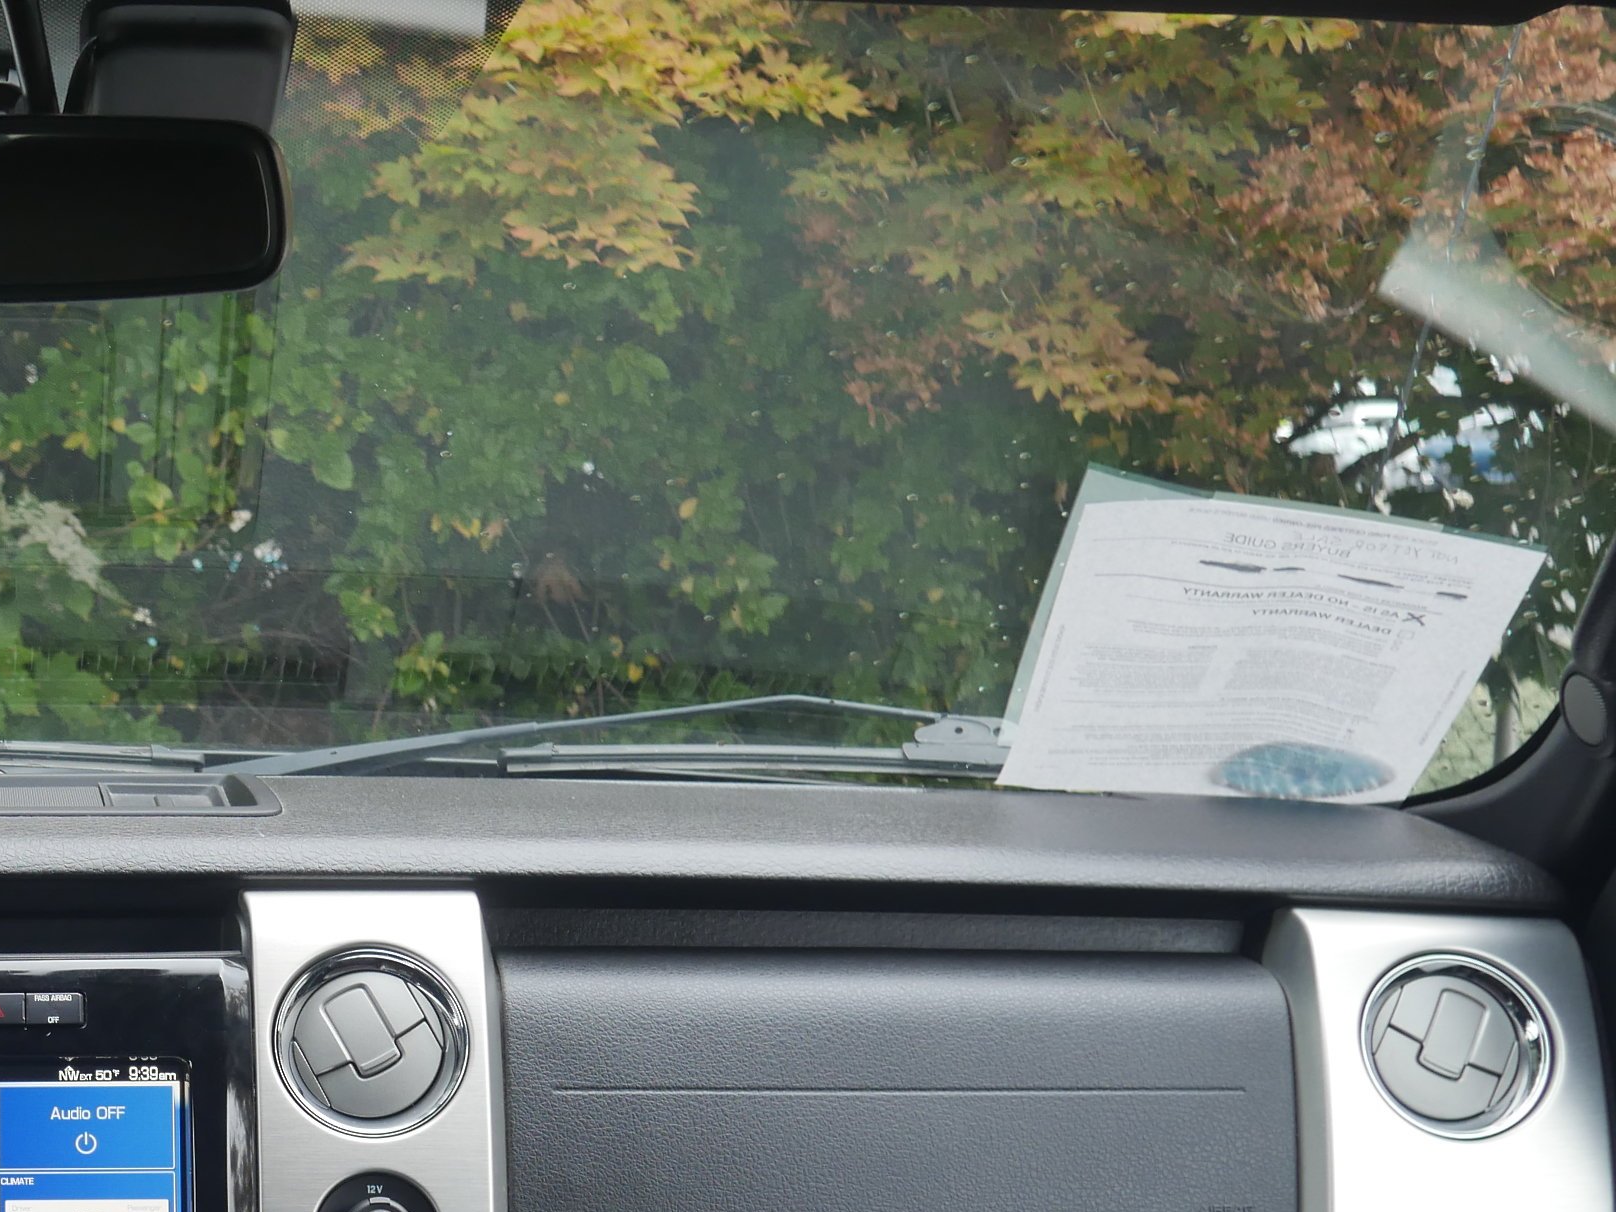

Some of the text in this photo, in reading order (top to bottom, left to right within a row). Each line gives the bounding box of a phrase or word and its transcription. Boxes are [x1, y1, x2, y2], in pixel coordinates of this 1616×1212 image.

[34, 994, 73, 1002] PASS AIRBAG
[47, 1016, 60, 1024] OFF
[58, 1068, 80, 1081] NW
[50, 1106, 126, 1120] Audio OFF
[0, 1177, 35, 1186] CLIMATE
[366, 1184, 384, 1194] 12V
